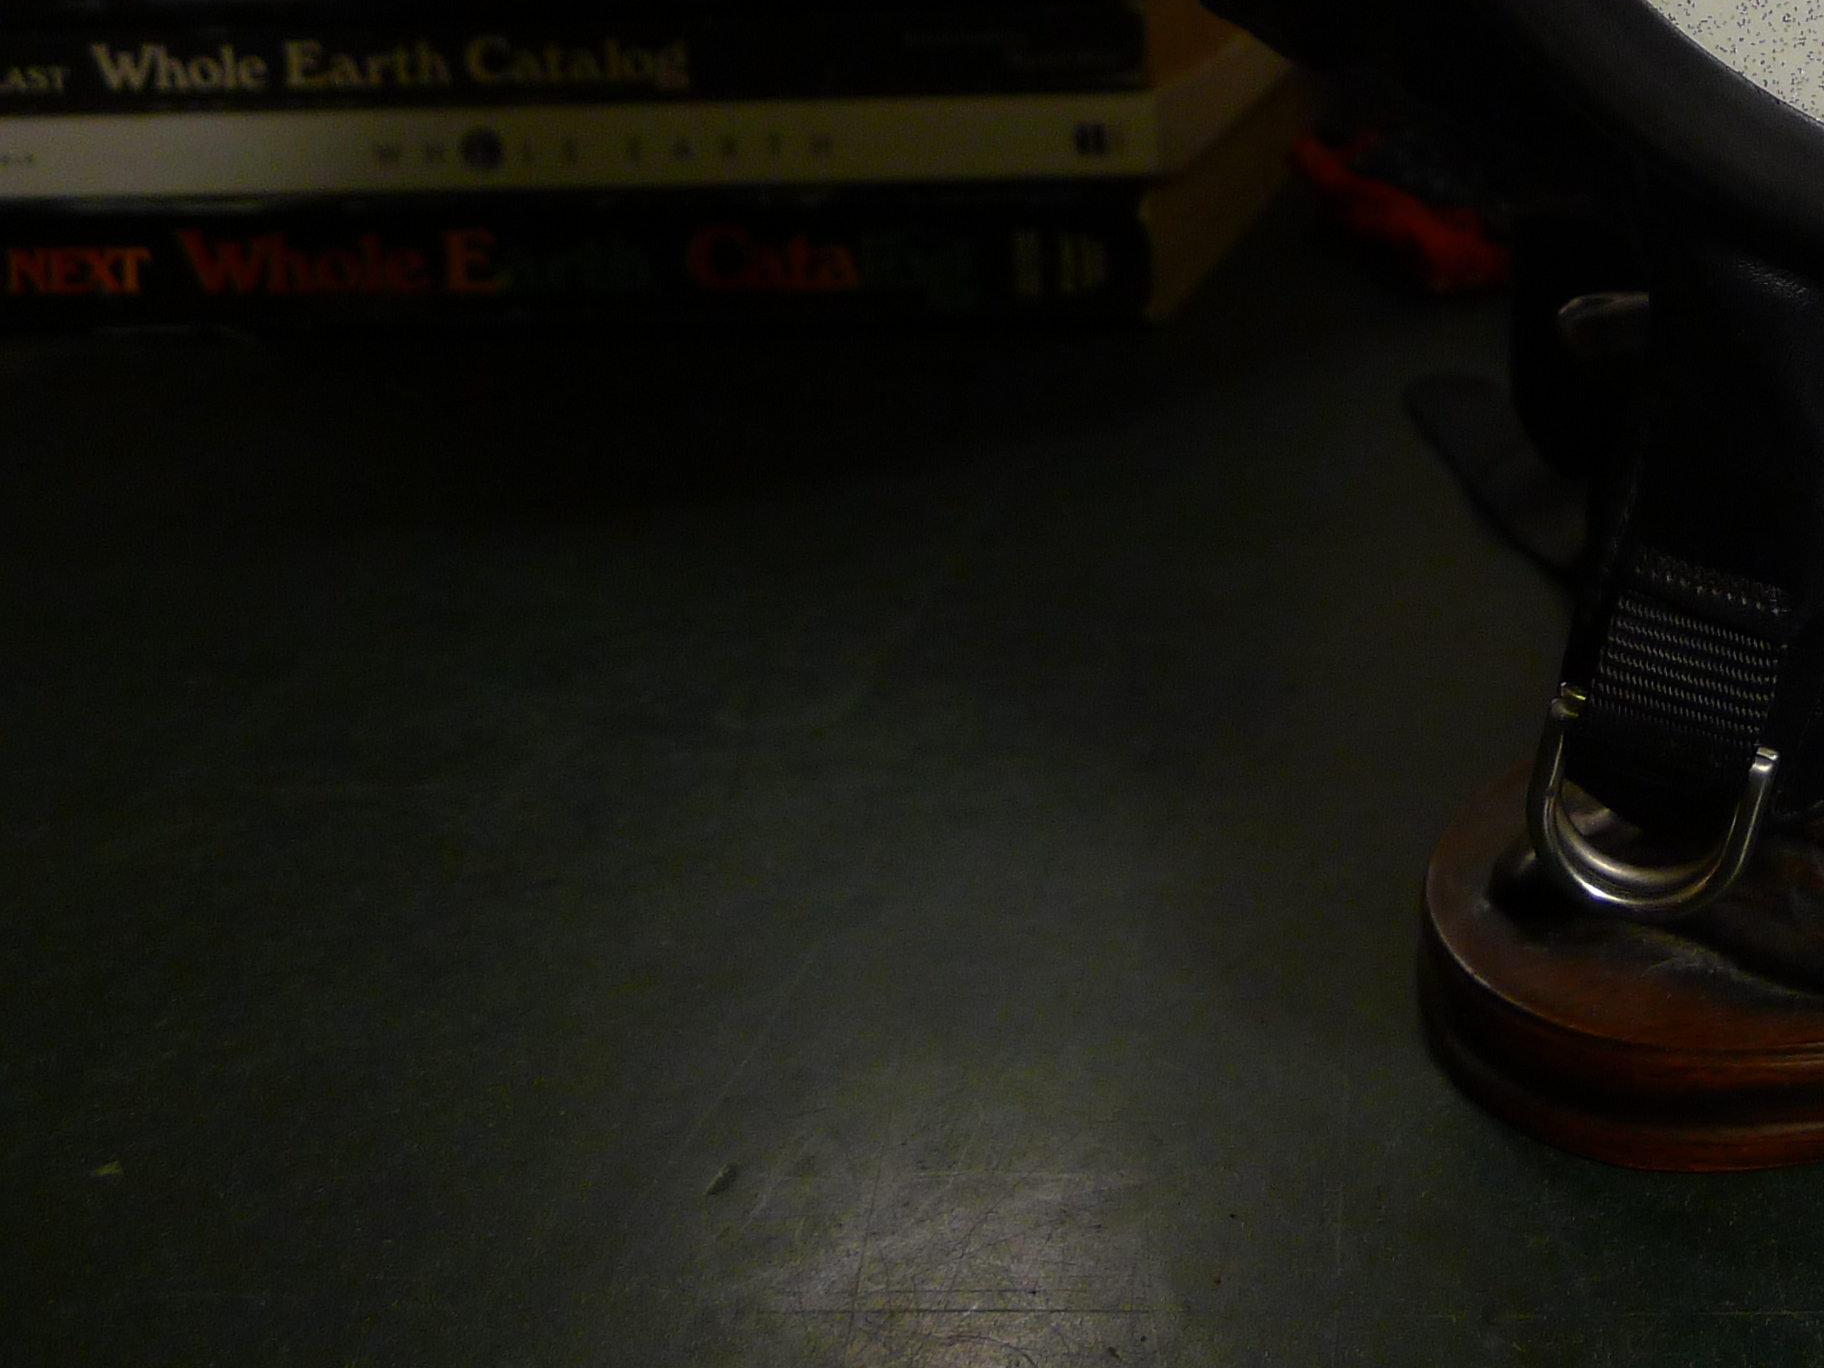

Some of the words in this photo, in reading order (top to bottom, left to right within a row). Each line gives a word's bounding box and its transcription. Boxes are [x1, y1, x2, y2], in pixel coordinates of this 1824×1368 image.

[88, 41, 270, 93] Whole
[281, 38, 452, 87] Earth
[463, 34, 690, 92] Catalog
[7, 246, 153, 296] NEXT
[174, 227, 429, 296] Whole
